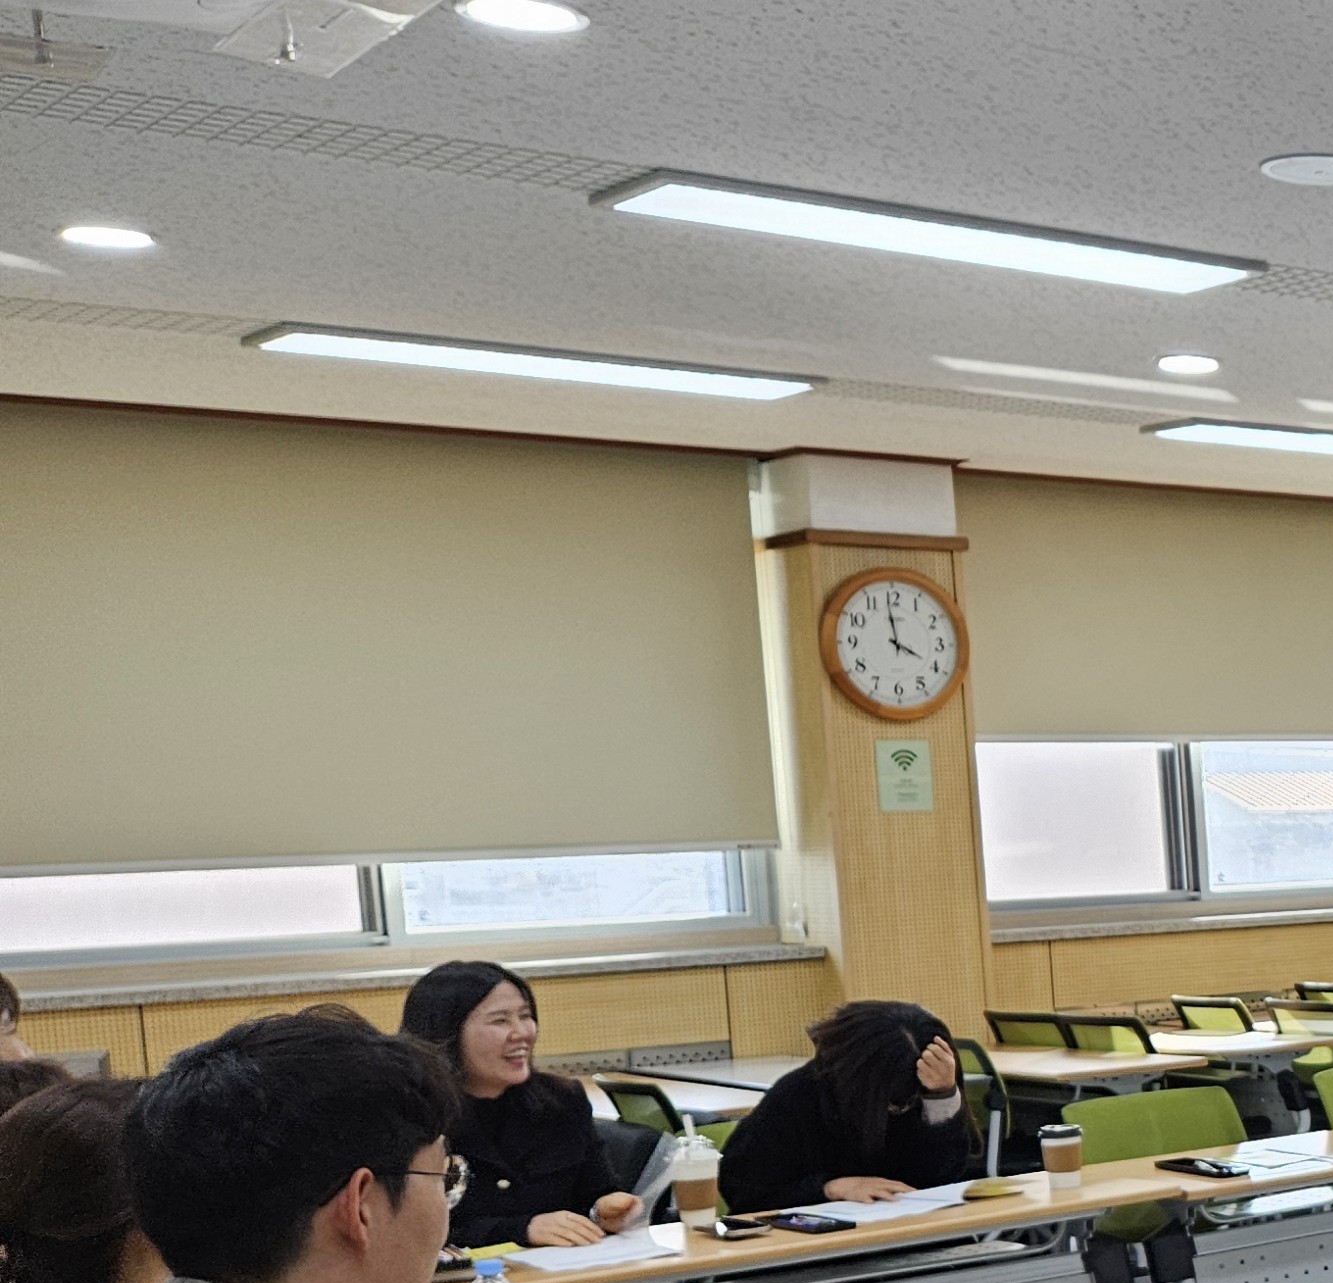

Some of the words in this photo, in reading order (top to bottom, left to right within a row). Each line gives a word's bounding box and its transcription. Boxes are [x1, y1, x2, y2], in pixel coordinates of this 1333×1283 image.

[866, 594, 877, 611] 11
[849, 611, 866, 629] 10
[927, 613, 937, 630] 2
[847, 633, 859, 650] 9
[934, 636, 945, 653] 3
[854, 656, 867, 673] 8
[929, 658, 940, 674] 4
[870, 675, 880, 691] 7
[893, 680, 904, 697] 6
[915, 674, 926, 691] 5
